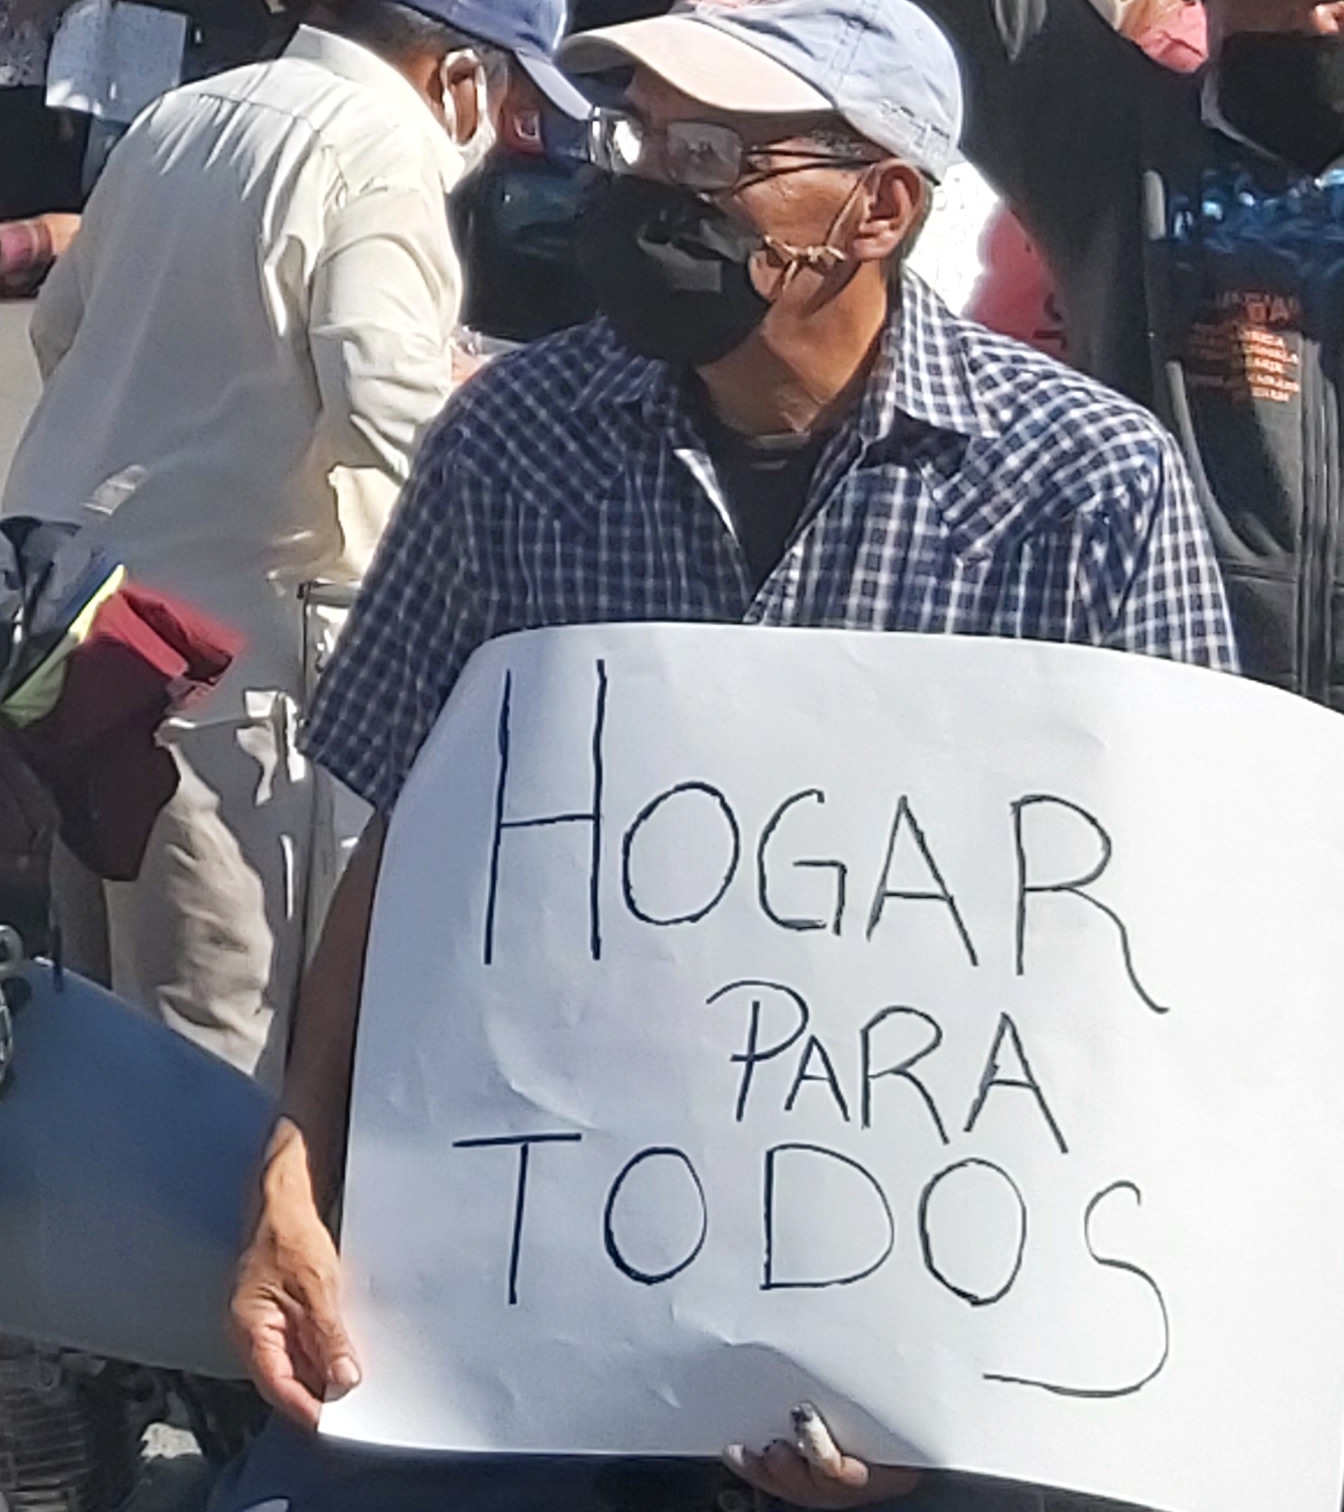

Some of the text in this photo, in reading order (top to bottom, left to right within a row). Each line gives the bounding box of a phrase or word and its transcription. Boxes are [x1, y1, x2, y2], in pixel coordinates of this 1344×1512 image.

[482, 658, 1171, 1015] HOGAR
[705, 979, 1071, 1156] PARA
[452, 1132, 1171, 1398] TODOS
